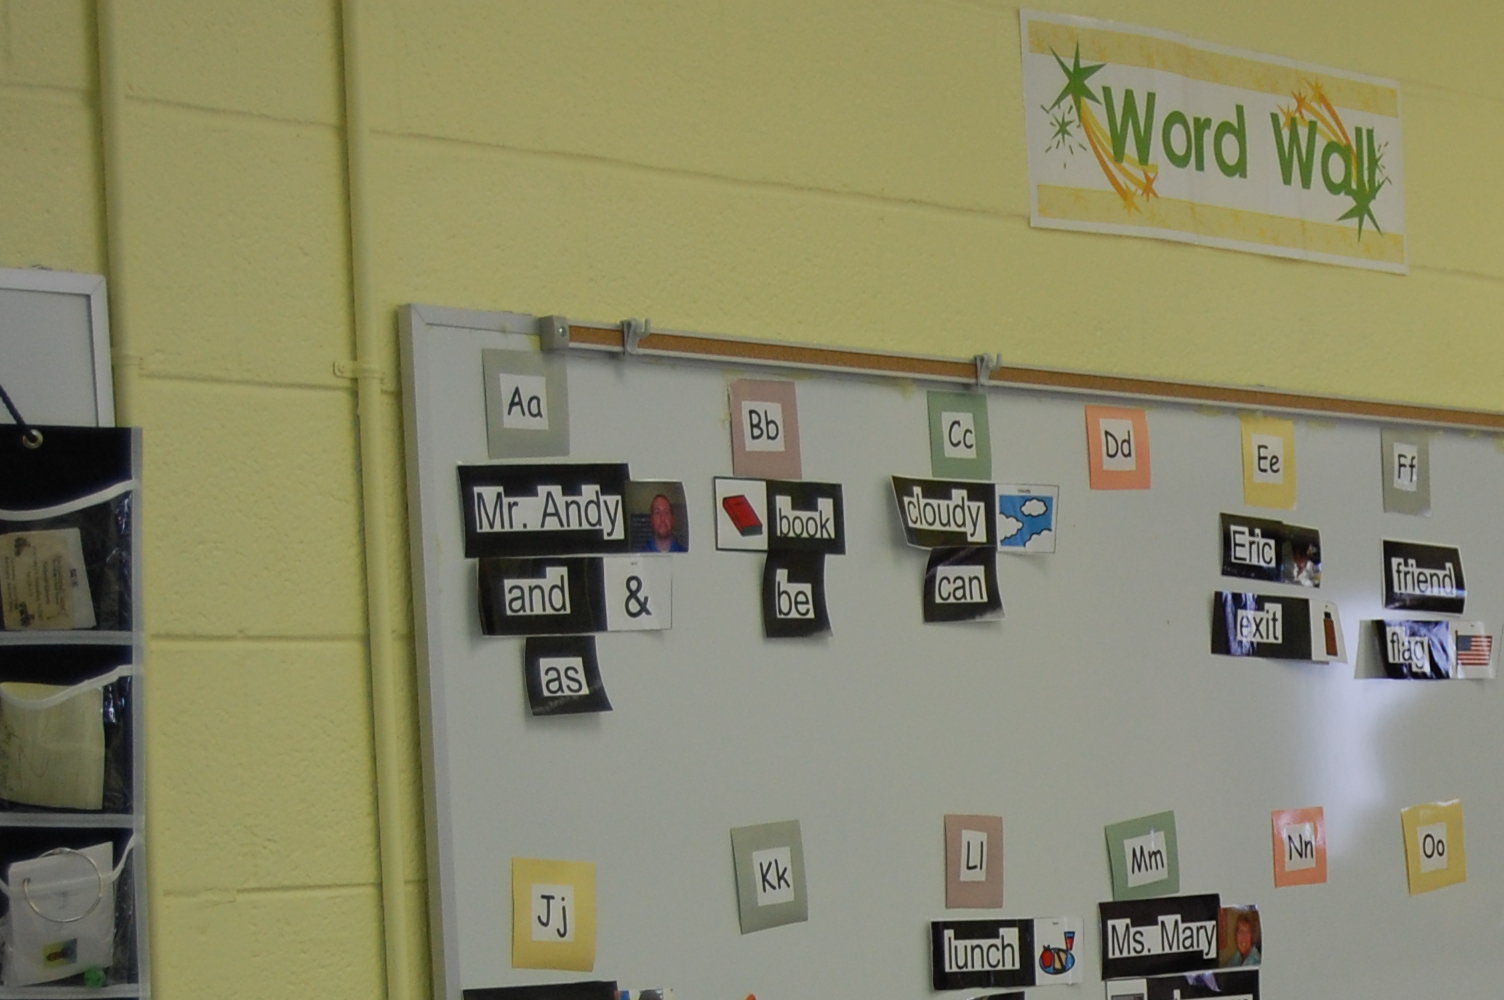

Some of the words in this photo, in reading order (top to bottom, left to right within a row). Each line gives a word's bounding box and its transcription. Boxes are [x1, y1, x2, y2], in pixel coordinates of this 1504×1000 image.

[1102, 85, 1248, 180] Word
[1270, 111, 1377, 200] Wall
[507, 385, 543, 419] Aa
[748, 408, 780, 442] Bb
[947, 419, 975, 450] Cc
[1104, 429, 1132, 459] Dd
[1257, 444, 1280, 474] Ee
[1396, 453, 1417, 483] Ff
[477, 491, 528, 532] Mr.
[540, 489, 621, 537] Andy
[777, 506, 834, 540] book
[906, 491, 981, 538] cloudy
[1232, 529, 1275, 567] Eric
[938, 573, 984, 603] can
[1395, 561, 1456, 596] friend
[507, 574, 569, 614] and
[624, 575, 653, 619] &
[776, 580, 812, 617] be
[1239, 608, 1281, 642] exit
[1390, 631, 1426, 670] flag
[544, 665, 584, 694] as
[964, 840, 984, 872] Ll
[1131, 844, 1166, 876] Mm
[1287, 833, 1315, 862] Nn
[1422, 832, 1446, 860] Oo
[758, 857, 792, 894] Kk
[536, 893, 569, 939] Jj
[947, 934, 1017, 972] lunch
[1111, 922, 1152, 958] Ms.
[1160, 918, 1217, 958] Mary
